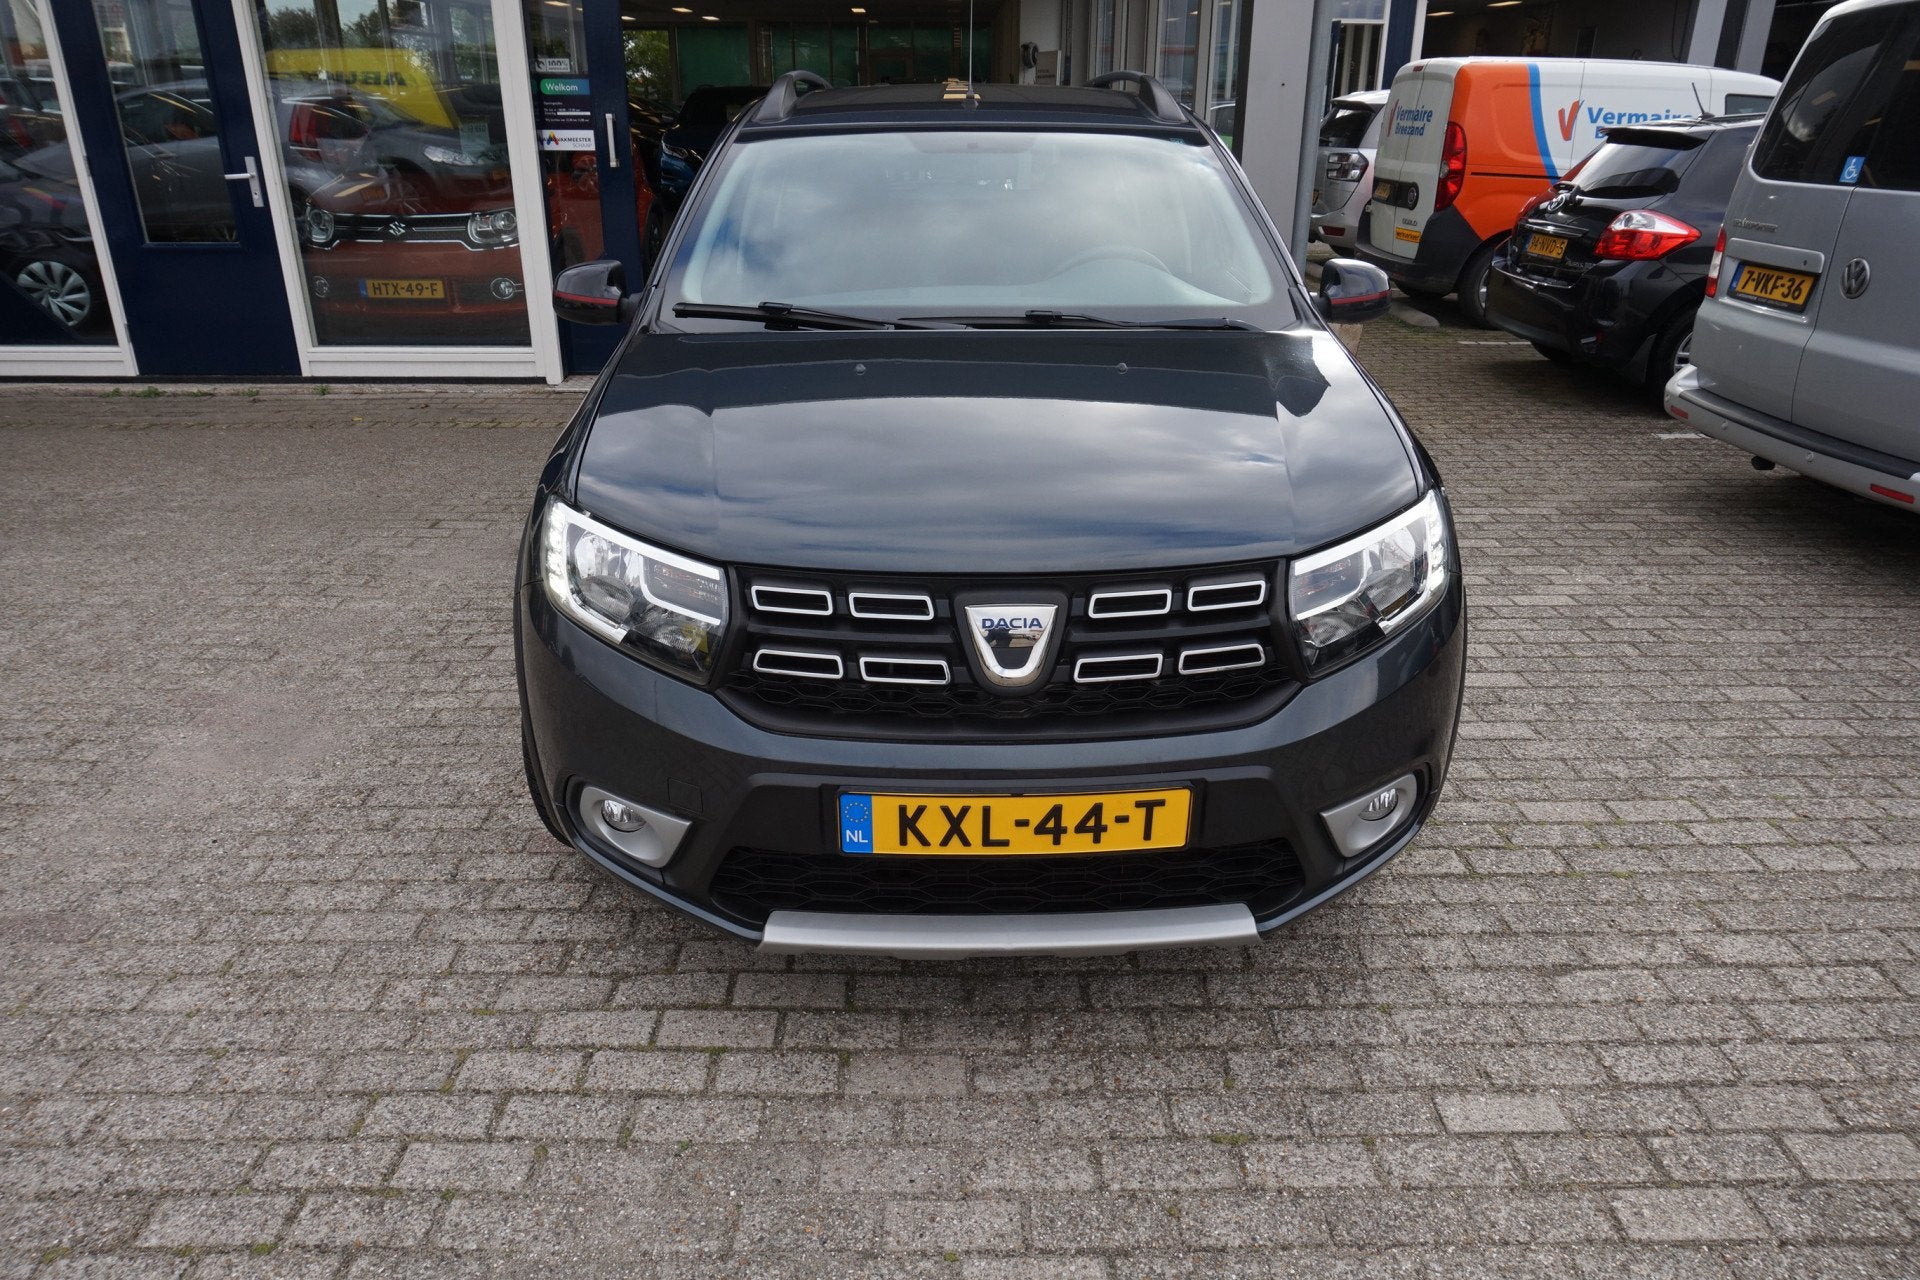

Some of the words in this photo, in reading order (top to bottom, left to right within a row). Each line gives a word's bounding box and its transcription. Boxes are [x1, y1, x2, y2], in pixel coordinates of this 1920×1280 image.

[545, 83, 579, 92] Welkom
[1396, 105, 1433, 123] Vermaire
[1587, 107, 1694, 125] Vermai
[1394, 121, 1426, 136] Breezand
[371, 281, 438, 296] HTX-49-F
[1741, 269, 1806, 300] 7-VKF-36
[981, 617, 1043, 629] DACIA
[845, 829, 869, 843] NL
[898, 799, 1167, 847] KXL-44-T
